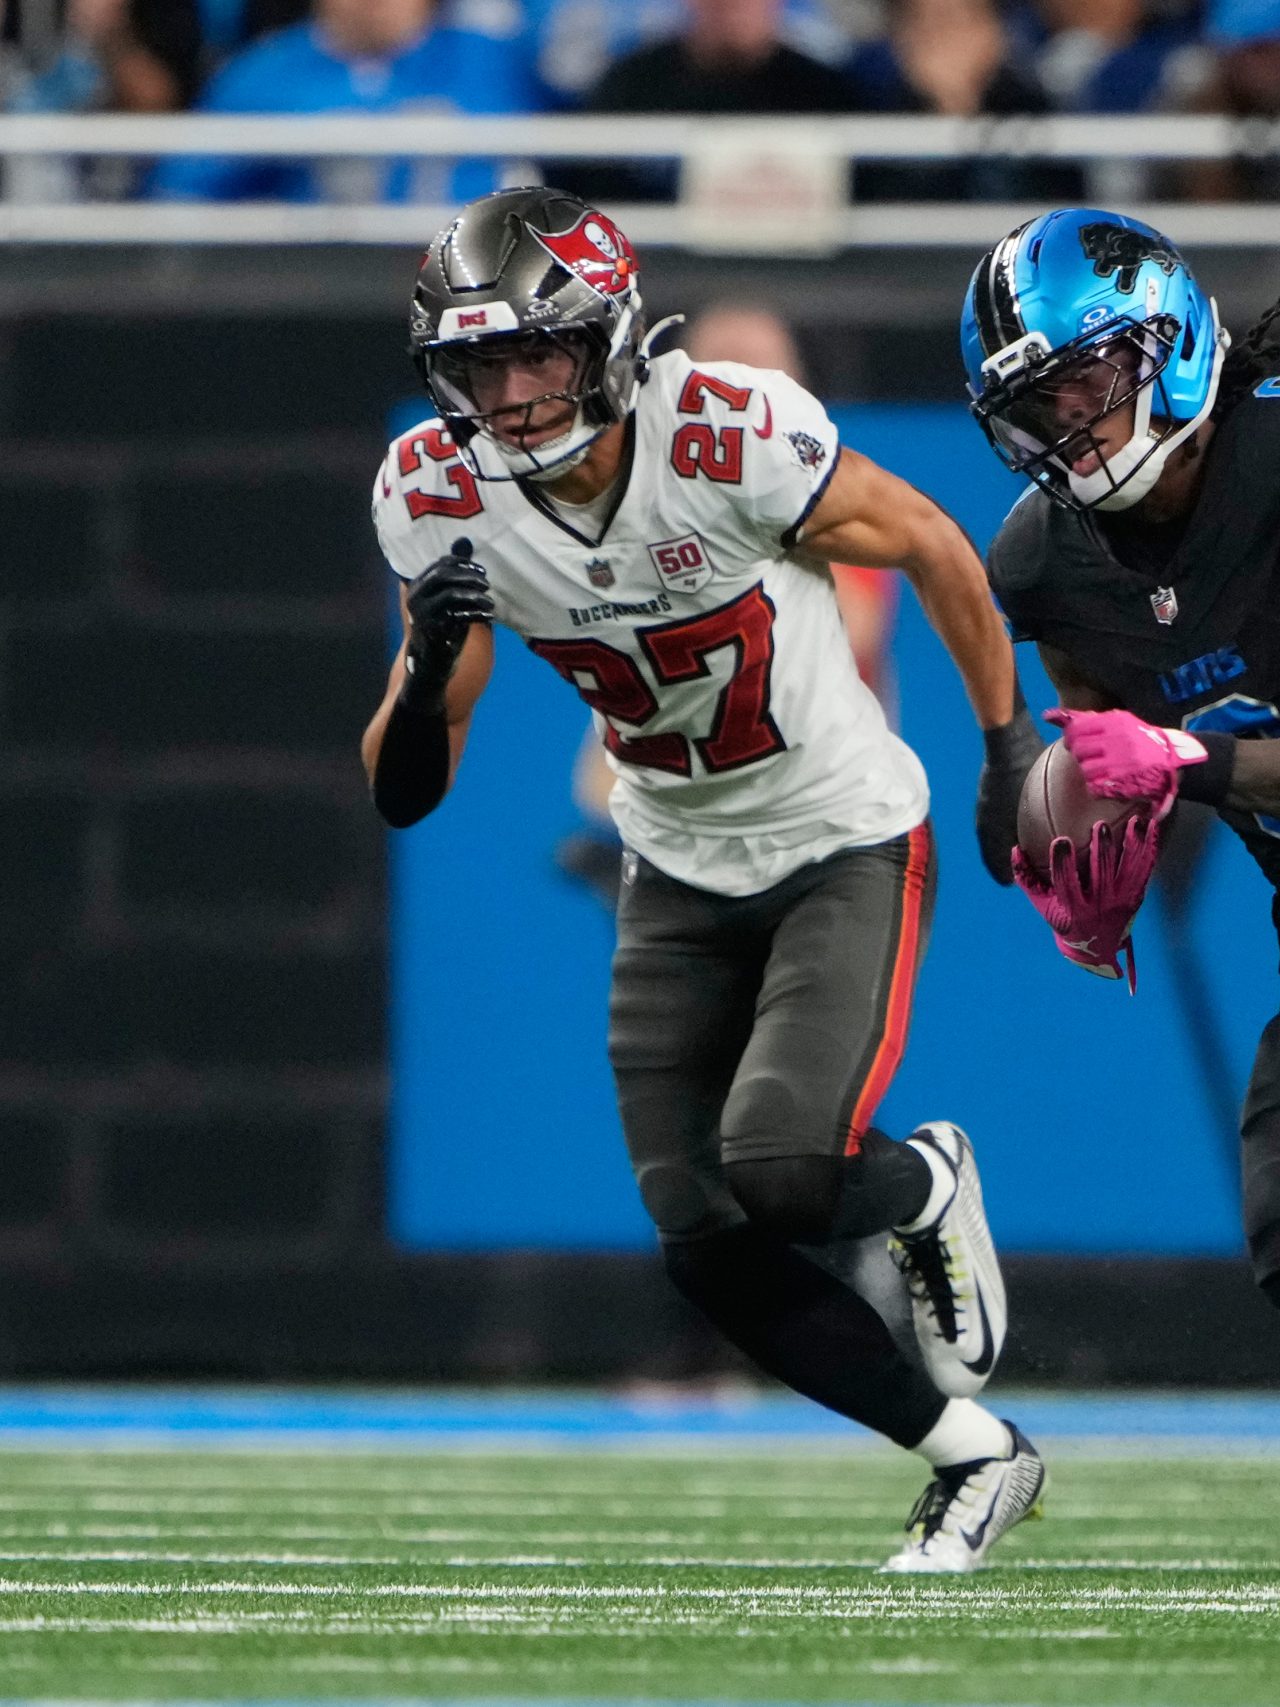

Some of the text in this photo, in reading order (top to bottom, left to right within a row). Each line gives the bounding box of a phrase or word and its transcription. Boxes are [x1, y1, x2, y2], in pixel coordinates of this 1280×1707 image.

[398, 424, 484, 521] 27
[671, 369, 754, 485] 27
[656, 542, 703, 575] 50
[525, 579, 788, 779] 27
